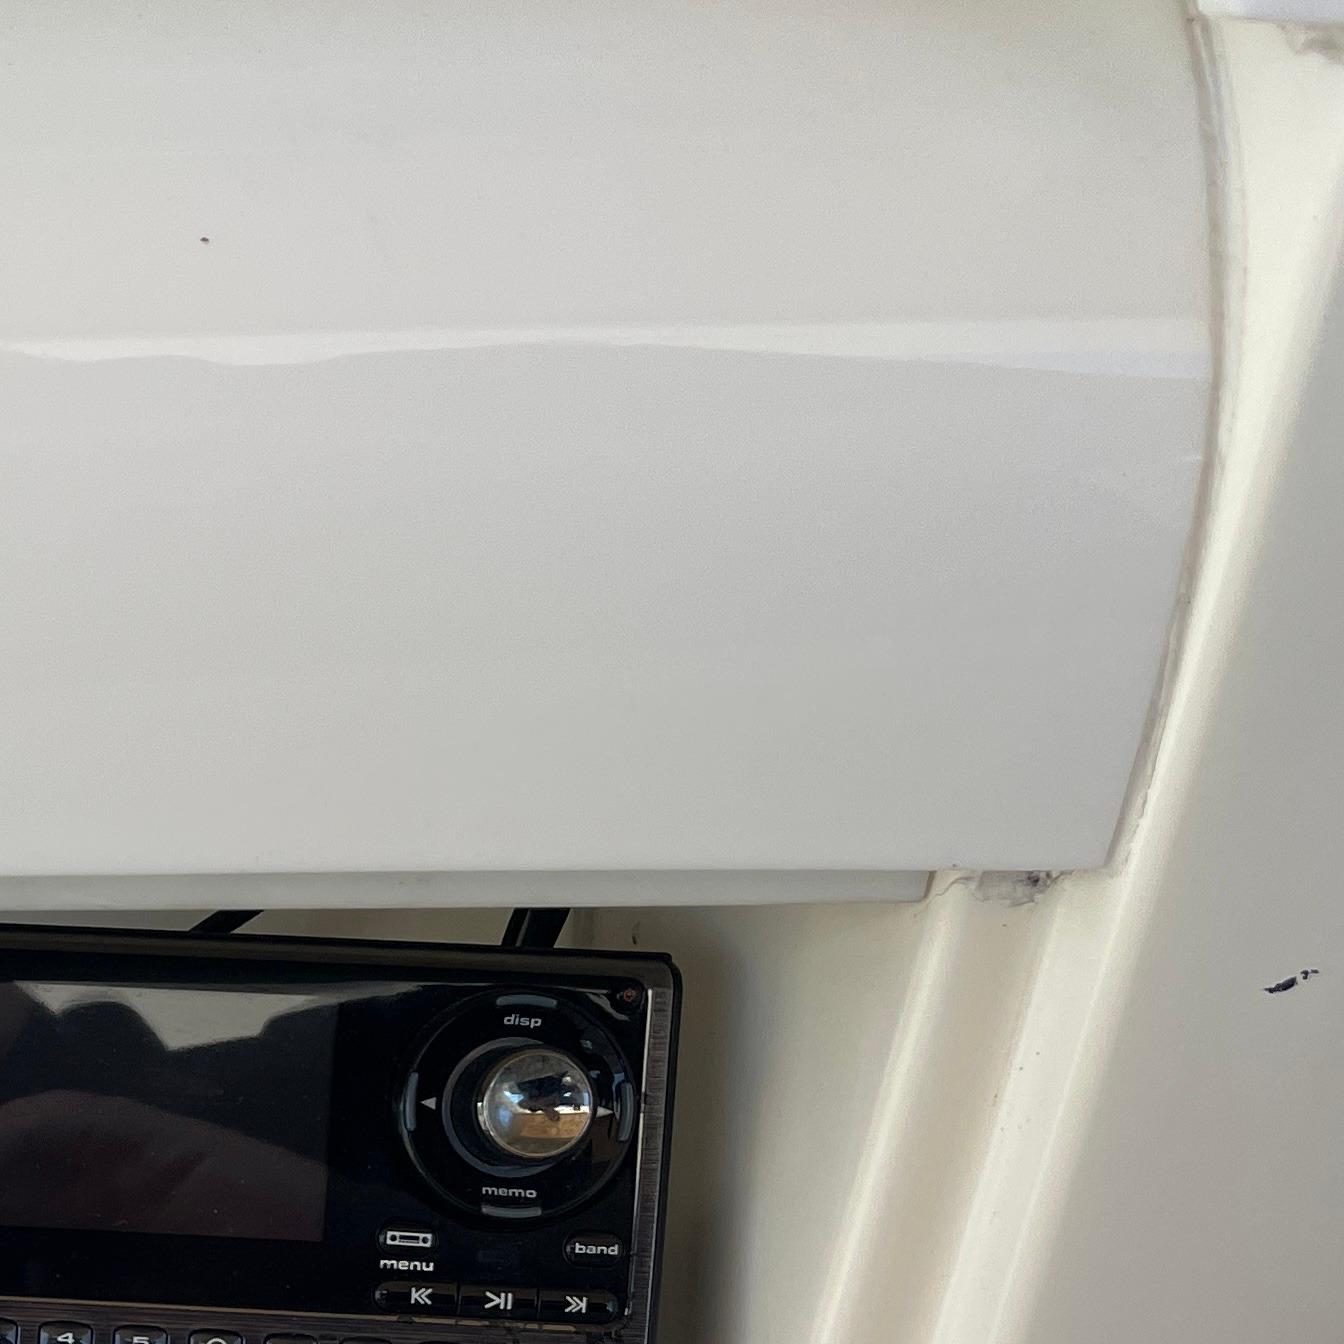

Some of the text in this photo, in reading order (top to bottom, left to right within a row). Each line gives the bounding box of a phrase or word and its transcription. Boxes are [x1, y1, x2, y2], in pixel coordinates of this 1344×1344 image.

[503, 1013, 542, 1029] disp
[481, 1184, 538, 1198] memo
[574, 1242, 620, 1256] band
[379, 1258, 435, 1272] menu
[56, 1331, 75, 1344] 4
